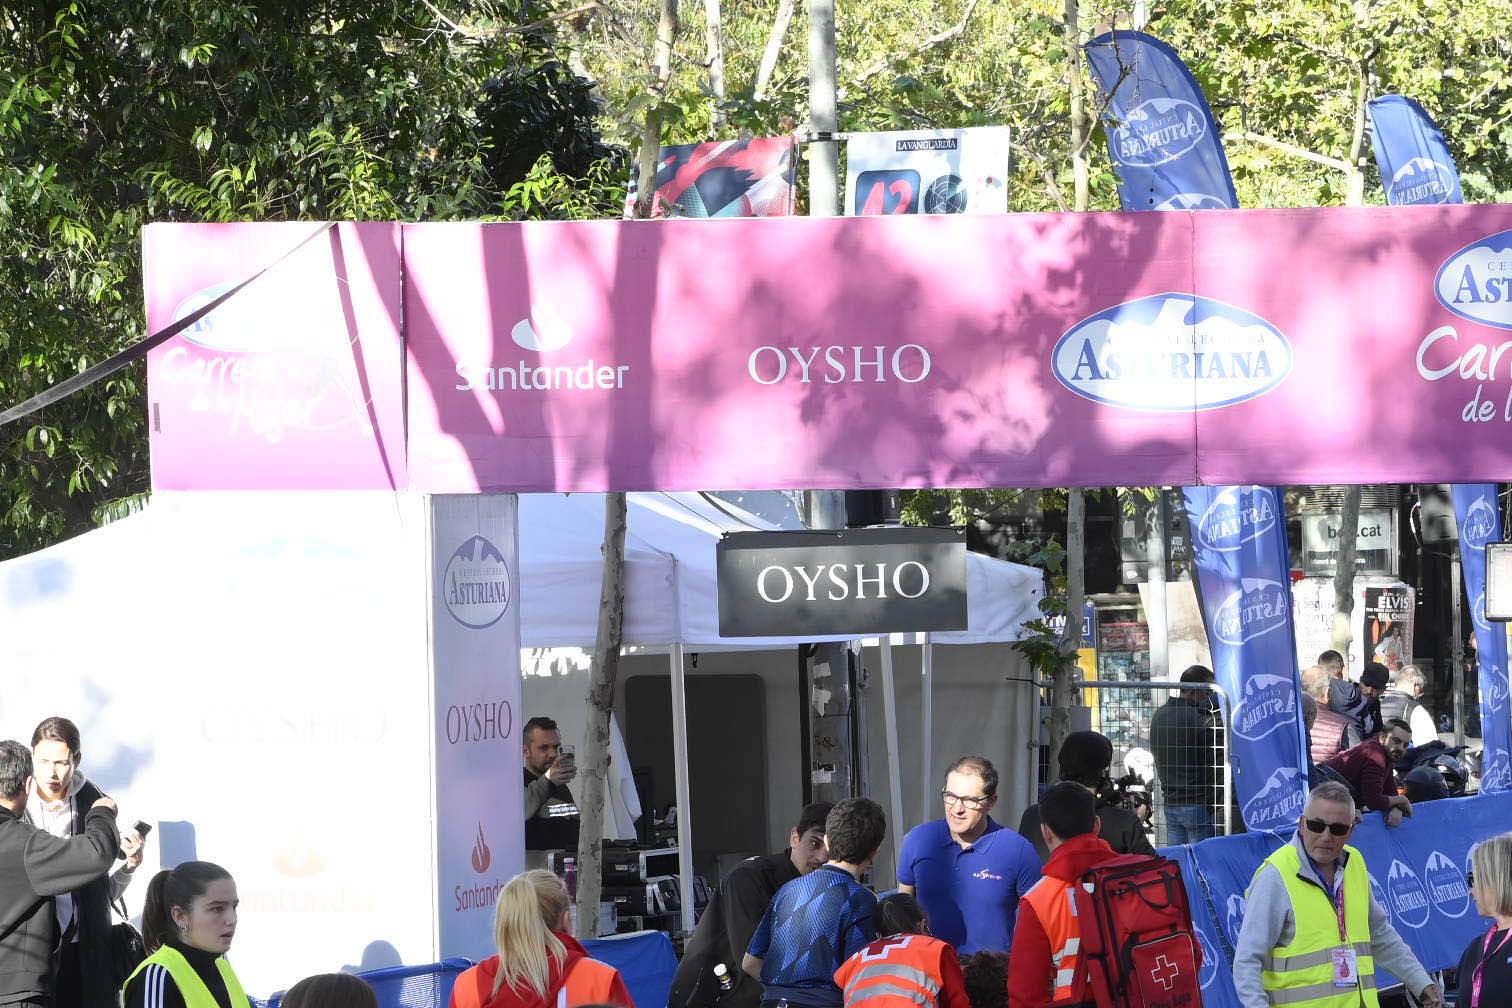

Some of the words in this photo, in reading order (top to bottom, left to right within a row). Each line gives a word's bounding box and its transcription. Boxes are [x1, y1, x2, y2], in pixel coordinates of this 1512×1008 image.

[455, 358, 631, 391] Santander
[747, 343, 932, 385] OYSHO
[1461, 383, 1497, 423] de
[449, 570, 508, 605] ASTURIANA
[755, 560, 931, 603] OYSHO
[1378, 595, 1409, 609] ELVIS
[447, 700, 513, 745] OYSHO
